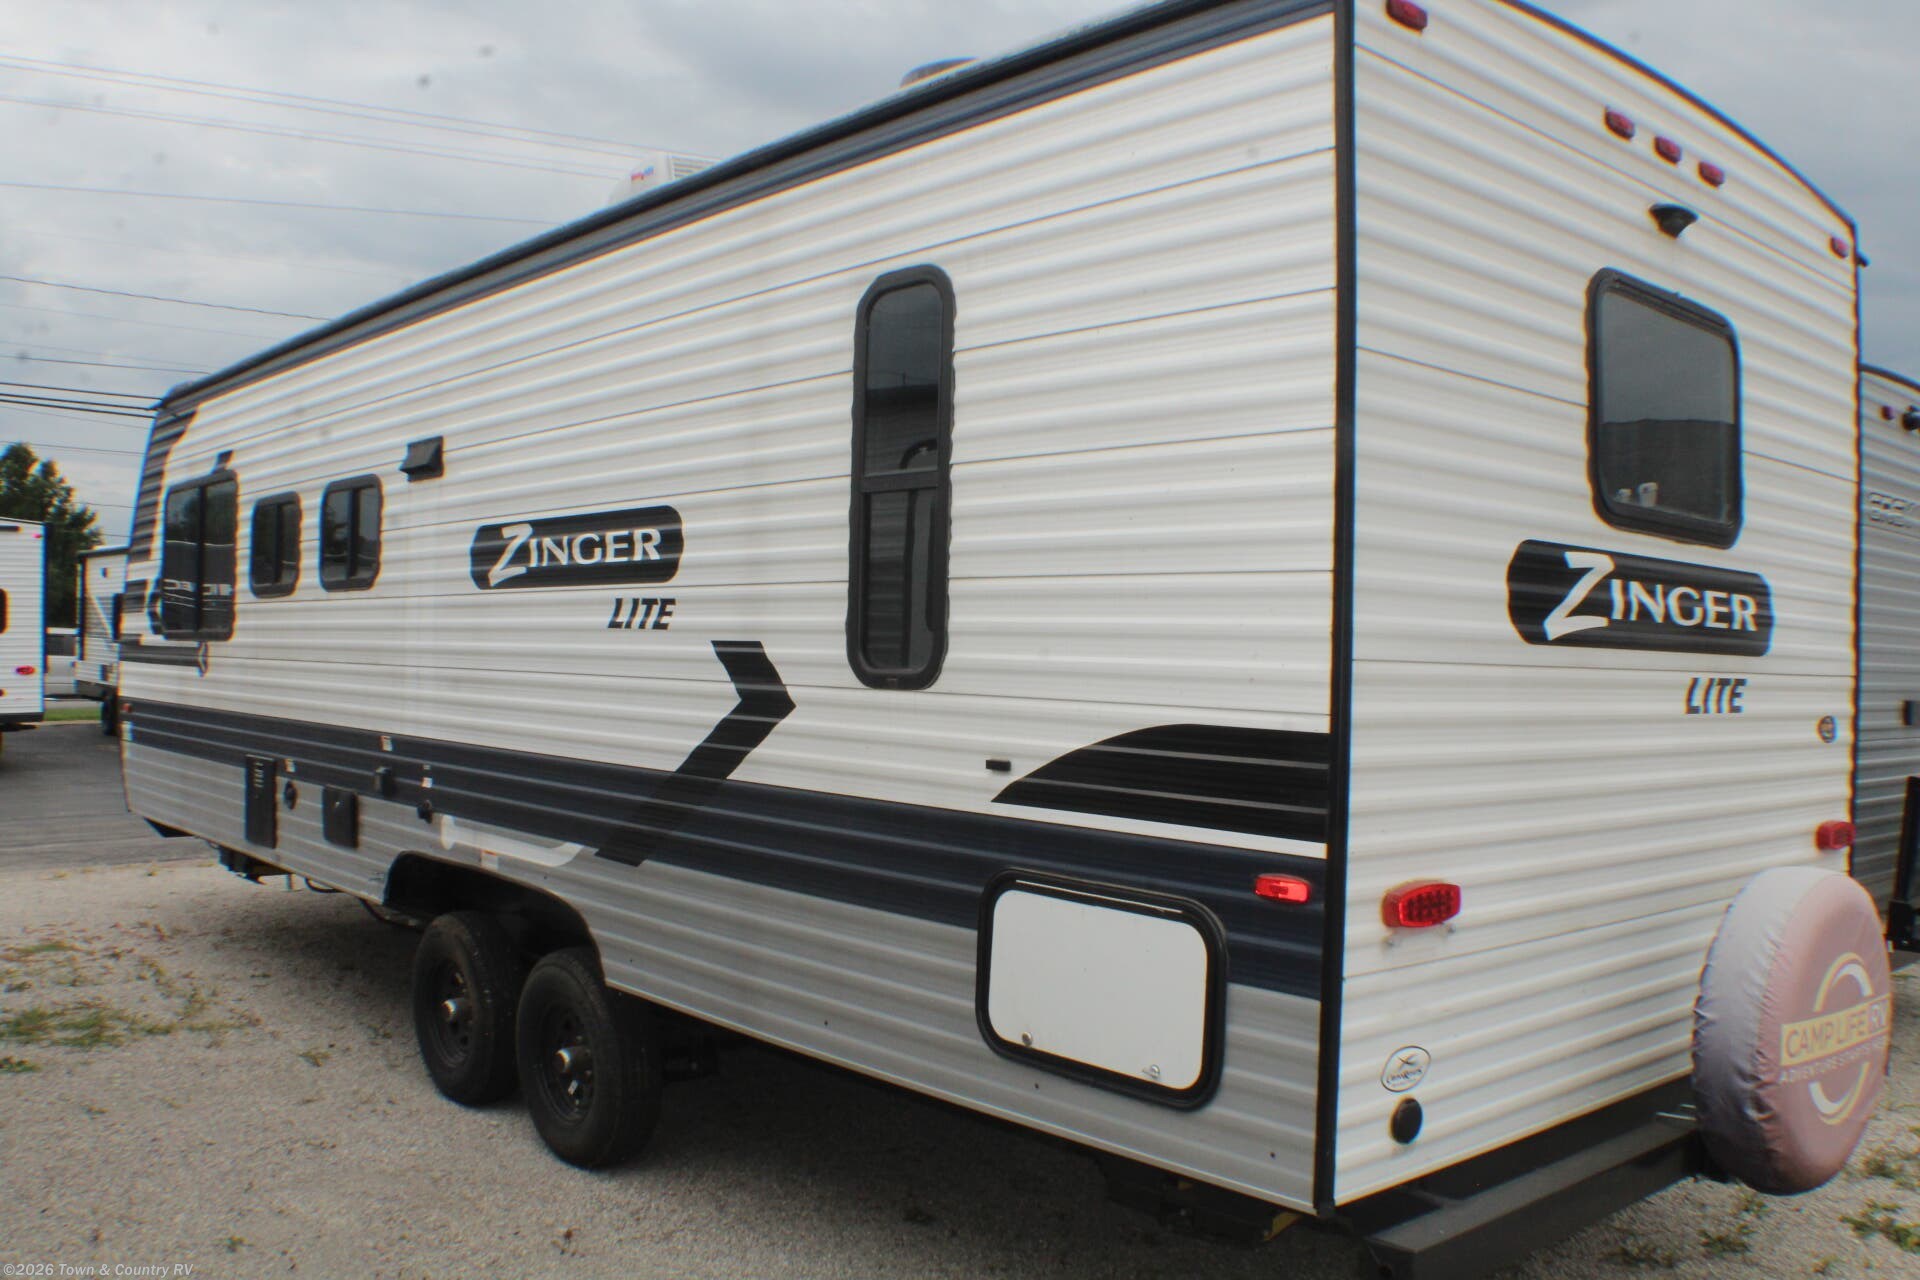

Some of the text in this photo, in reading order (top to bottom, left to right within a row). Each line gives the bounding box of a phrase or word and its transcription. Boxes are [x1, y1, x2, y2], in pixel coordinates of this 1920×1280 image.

[487, 523, 662, 587] ZINGER
[607, 597, 677, 630] LITE
[1543, 551, 1759, 641] ZINGER
[1685, 677, 1748, 714] LITE
[1785, 1021, 1834, 1058] CAMP
[1836, 1009, 1867, 1044] LIFE
